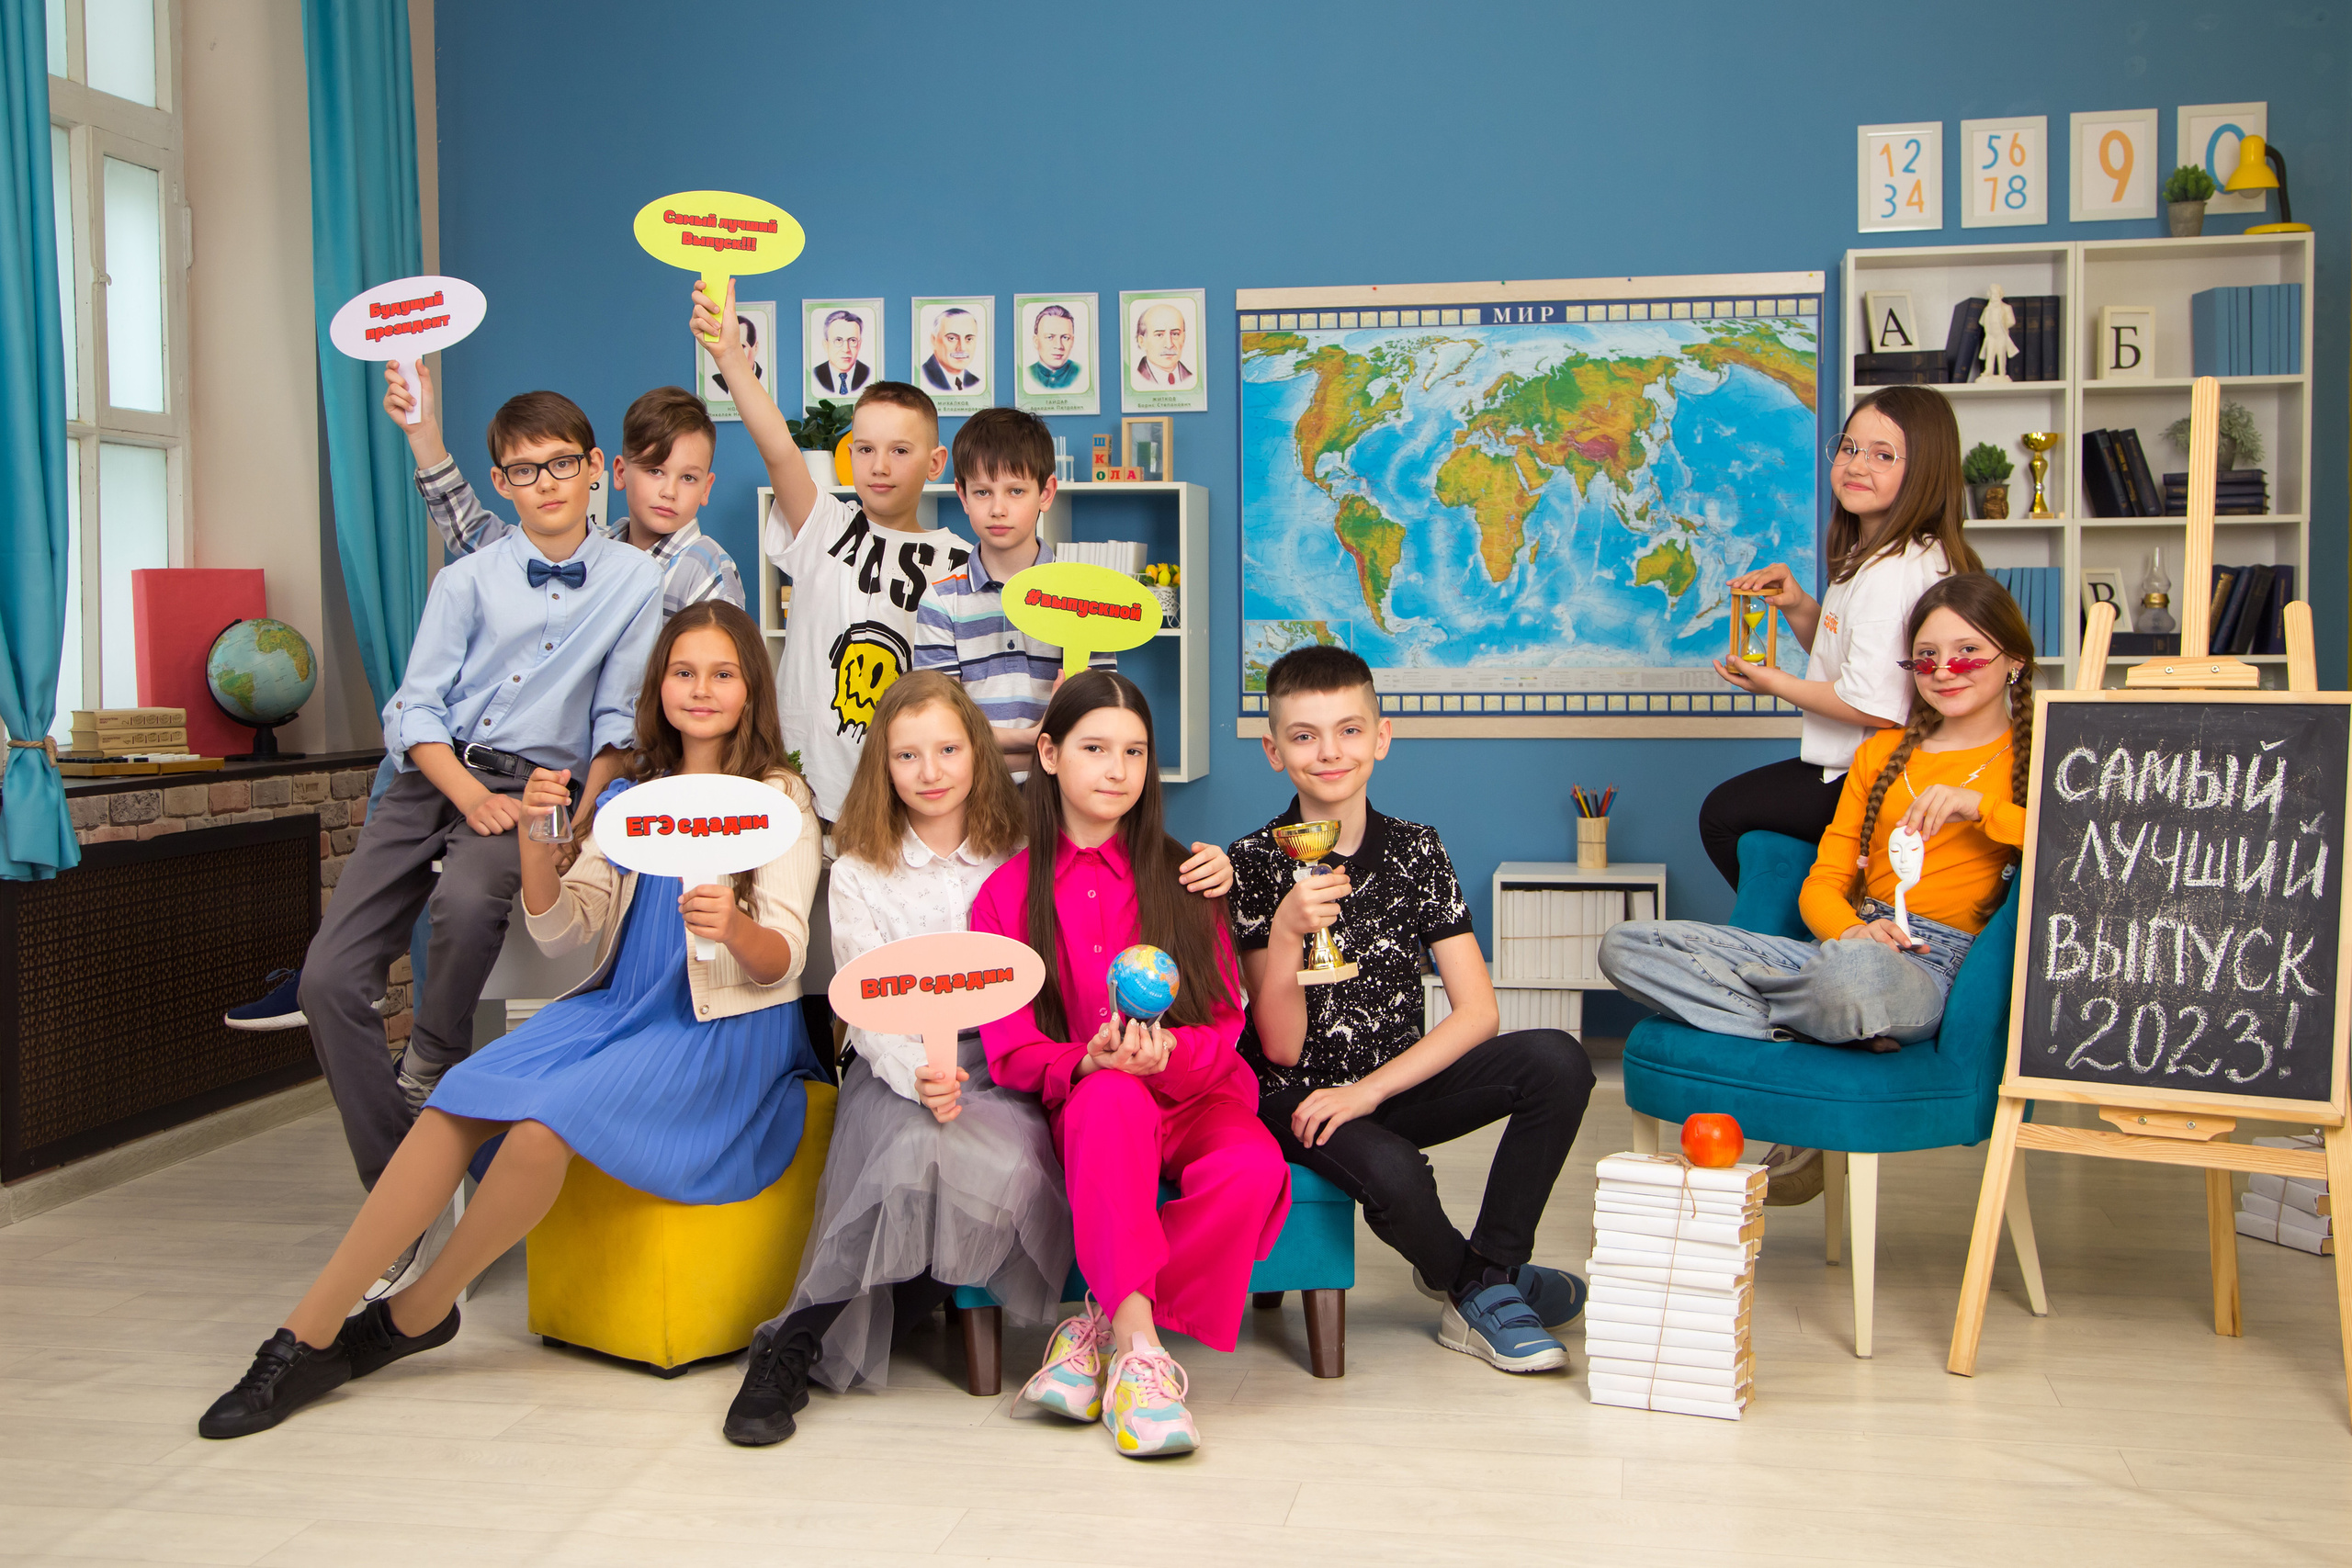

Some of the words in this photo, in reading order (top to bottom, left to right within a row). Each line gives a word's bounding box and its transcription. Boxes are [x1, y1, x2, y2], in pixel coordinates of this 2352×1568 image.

[2098, 130, 2134, 203] 9
[662, 209, 718, 229] Самый
[718, 215, 779, 234] лучший
[681, 231, 757, 253] Выпуск!!!
[369, 290, 445, 319] Будущий
[1493, 306, 1555, 323] МИР
[365, 312, 451, 343] президент
[1880, 308, 1913, 347] А
[2110, 325, 2142, 369] Б
[1023, 589, 1143, 622] #выпускной
[2054, 739, 2288, 815] САМЫЙ
[626, 814, 675, 838] ЕГЭ
[677, 814, 770, 838] сдадим
[2069, 812, 2329, 899] ЛУЧШИЙ
[2045, 913, 2323, 997] ВЫПУСК
[861, 974, 917, 1000] ВПР
[919, 966, 1014, 996] сдадим
